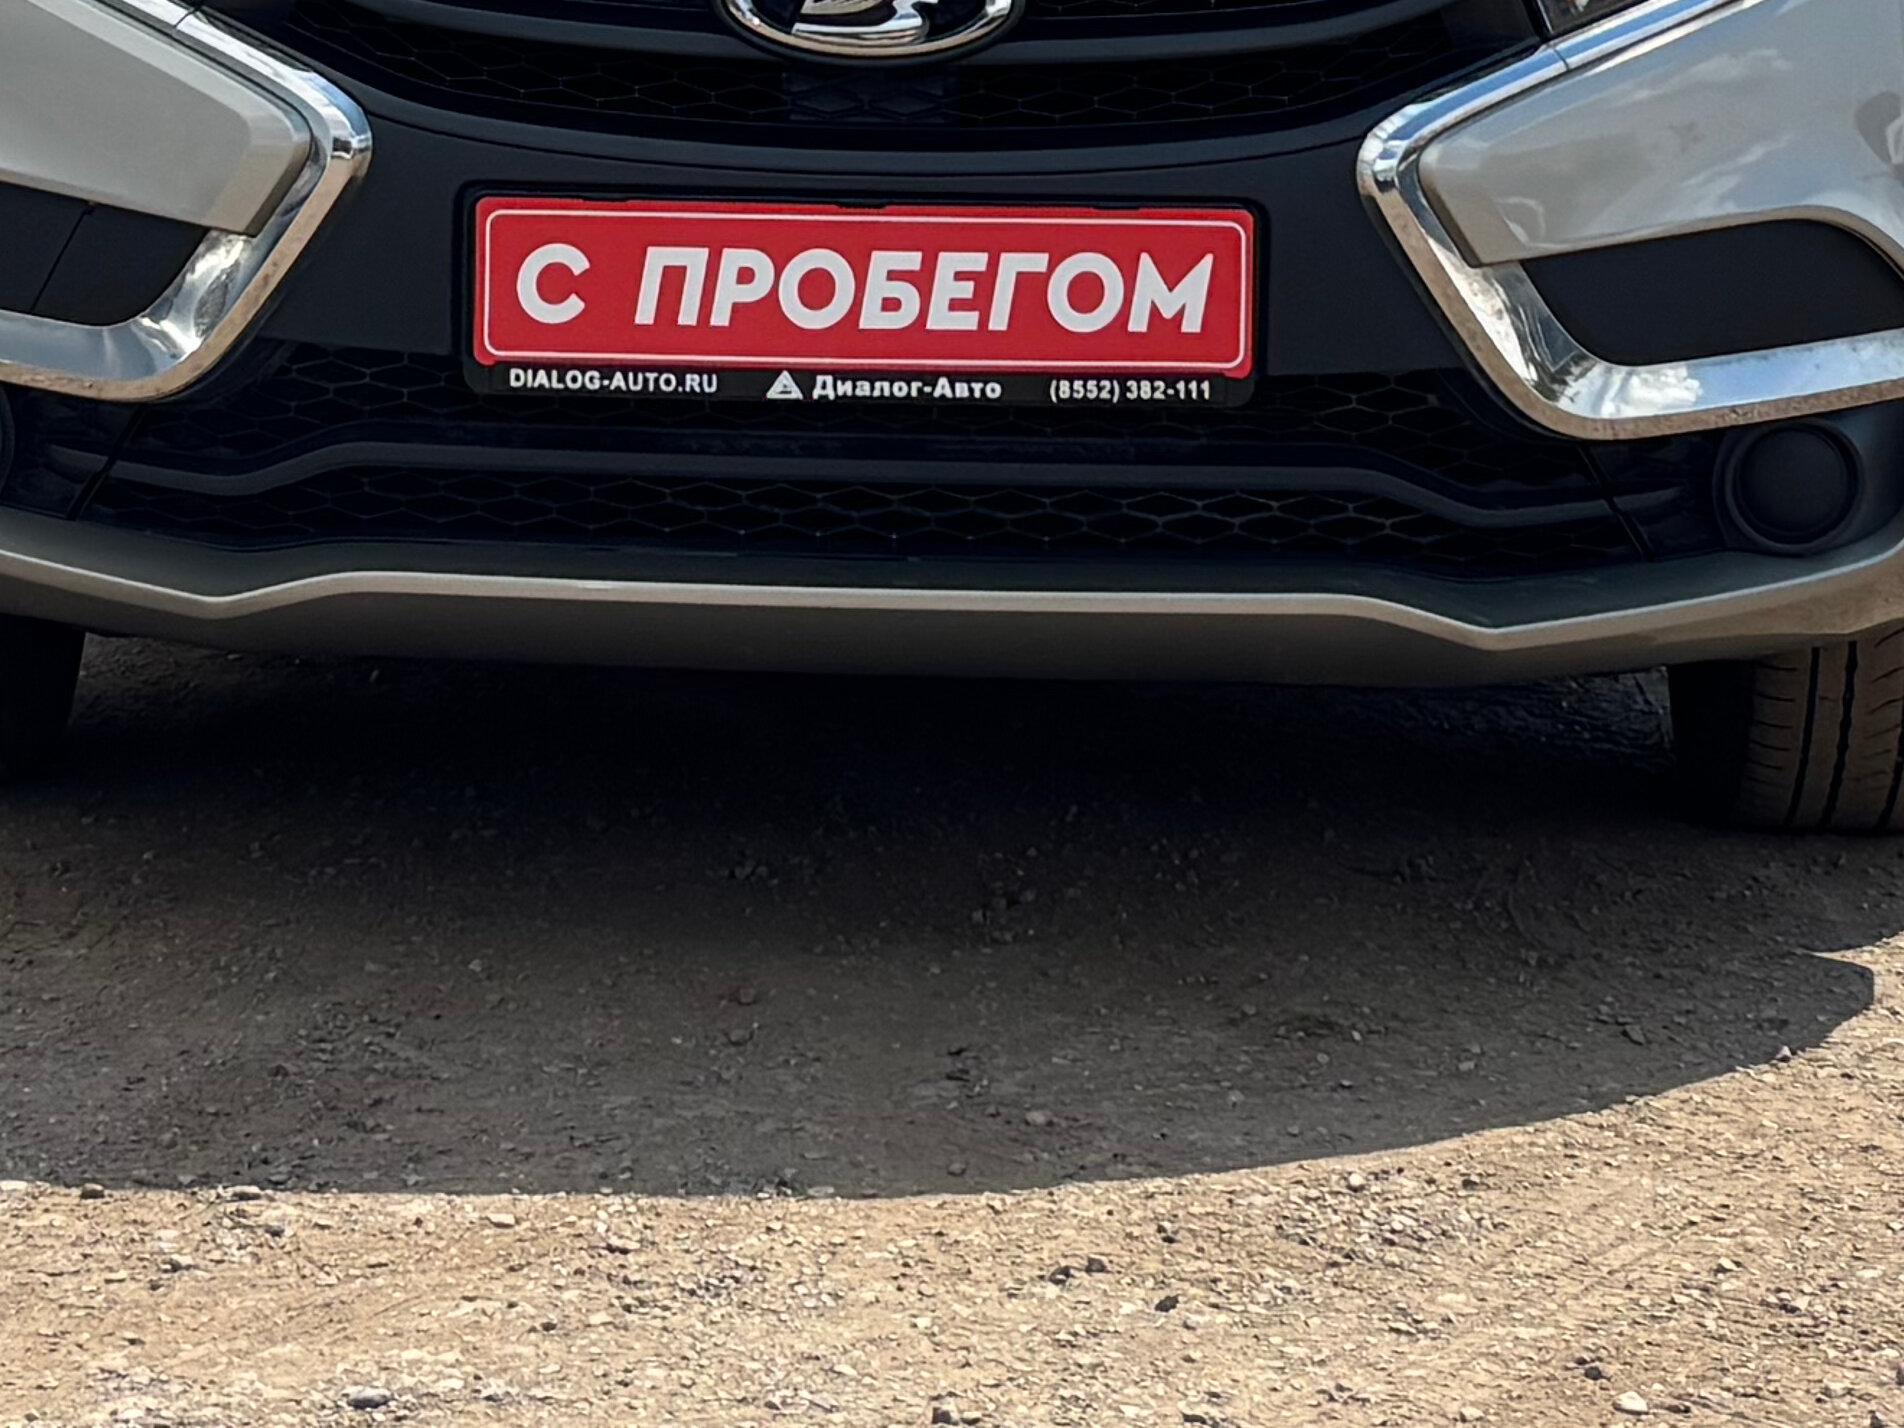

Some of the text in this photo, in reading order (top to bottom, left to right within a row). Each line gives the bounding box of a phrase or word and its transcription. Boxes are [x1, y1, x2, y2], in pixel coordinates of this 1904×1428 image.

[516, 242, 1214, 334] С ПРОБЕГОМ
[508, 367, 718, 394] DIALOG-AUTO.RU
[812, 374, 1002, 401] Диалог-Авто
[1048, 379, 1211, 403] (8552) 382-111
